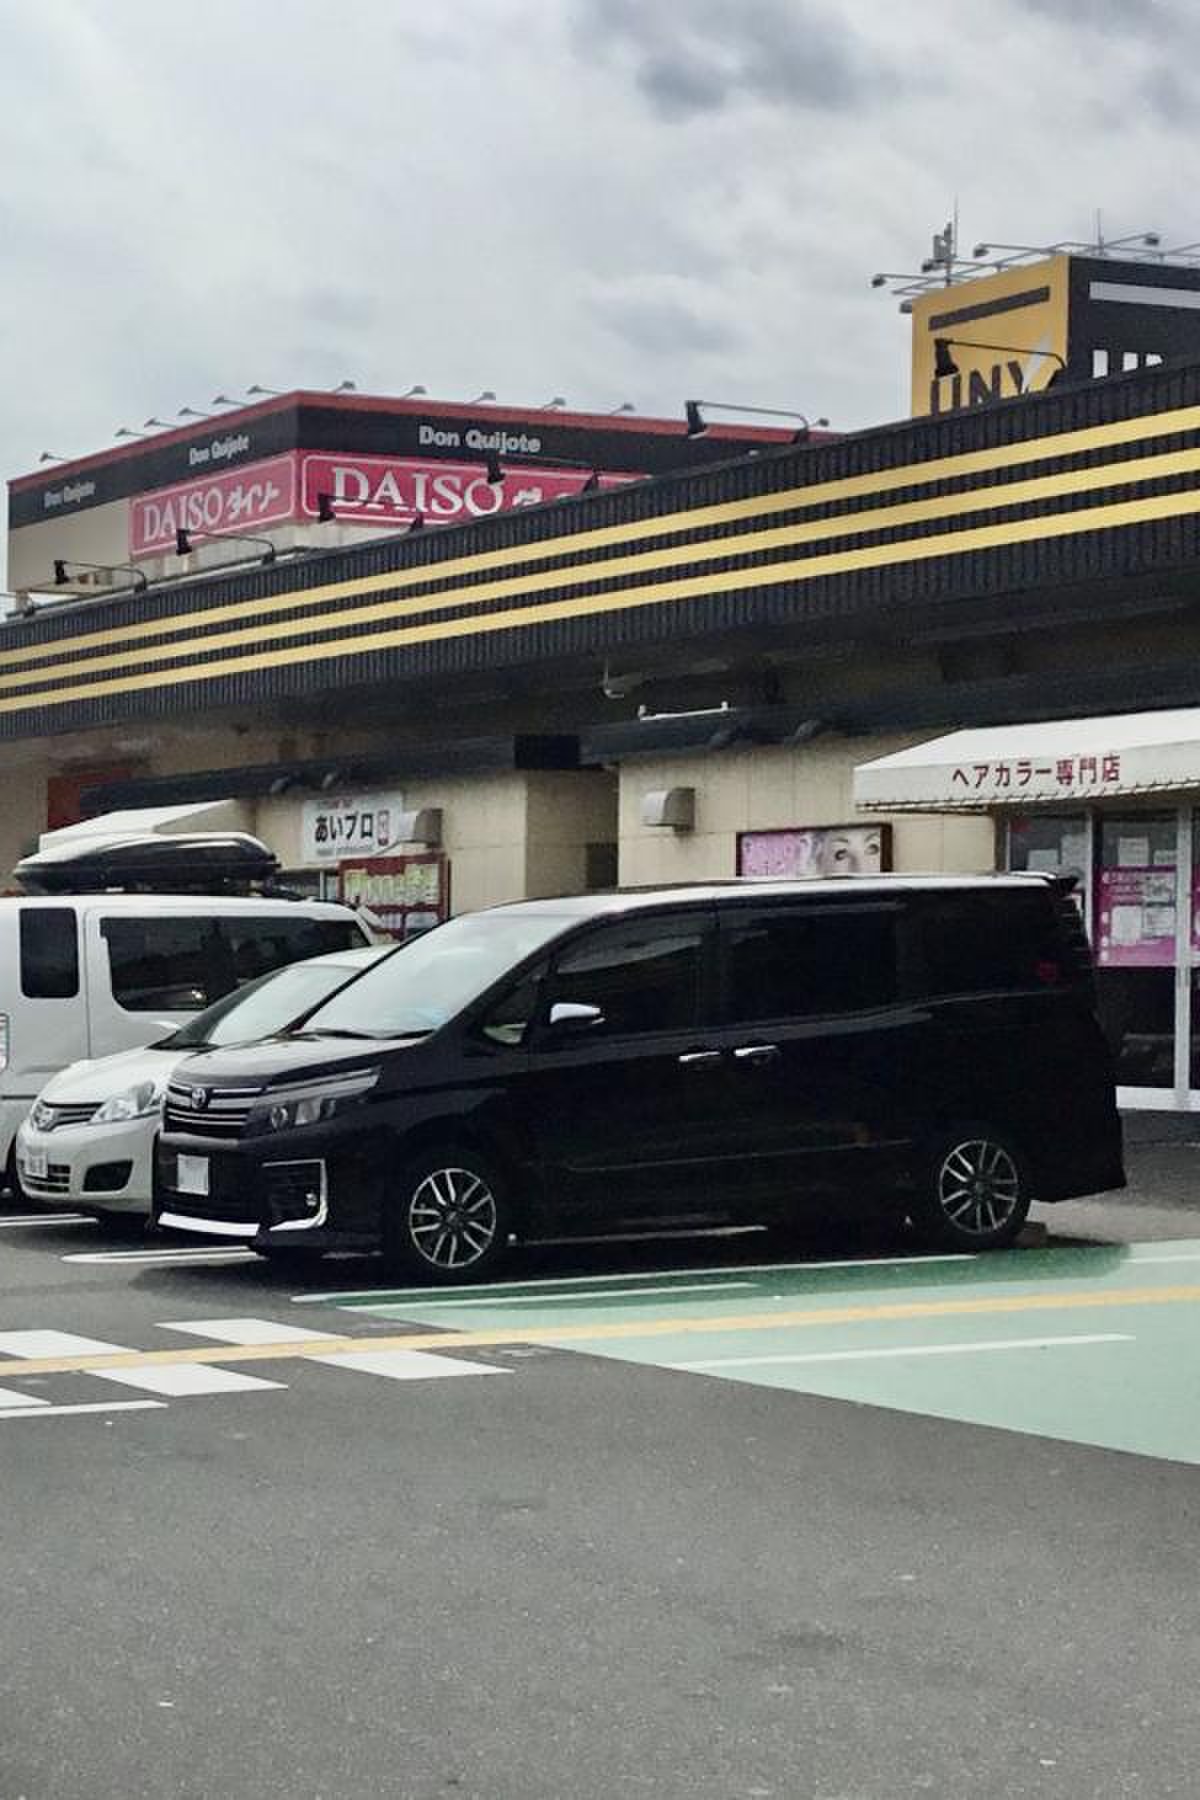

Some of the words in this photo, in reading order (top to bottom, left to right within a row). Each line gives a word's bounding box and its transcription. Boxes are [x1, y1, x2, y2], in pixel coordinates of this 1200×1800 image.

[419, 425, 460, 447] Don
[465, 429, 542, 454] Quijote
[331, 466, 504, 515] DAISO
[143, 487, 223, 542] DAISO
[952, 754, 1121, 789] ヘアカラー専門店
